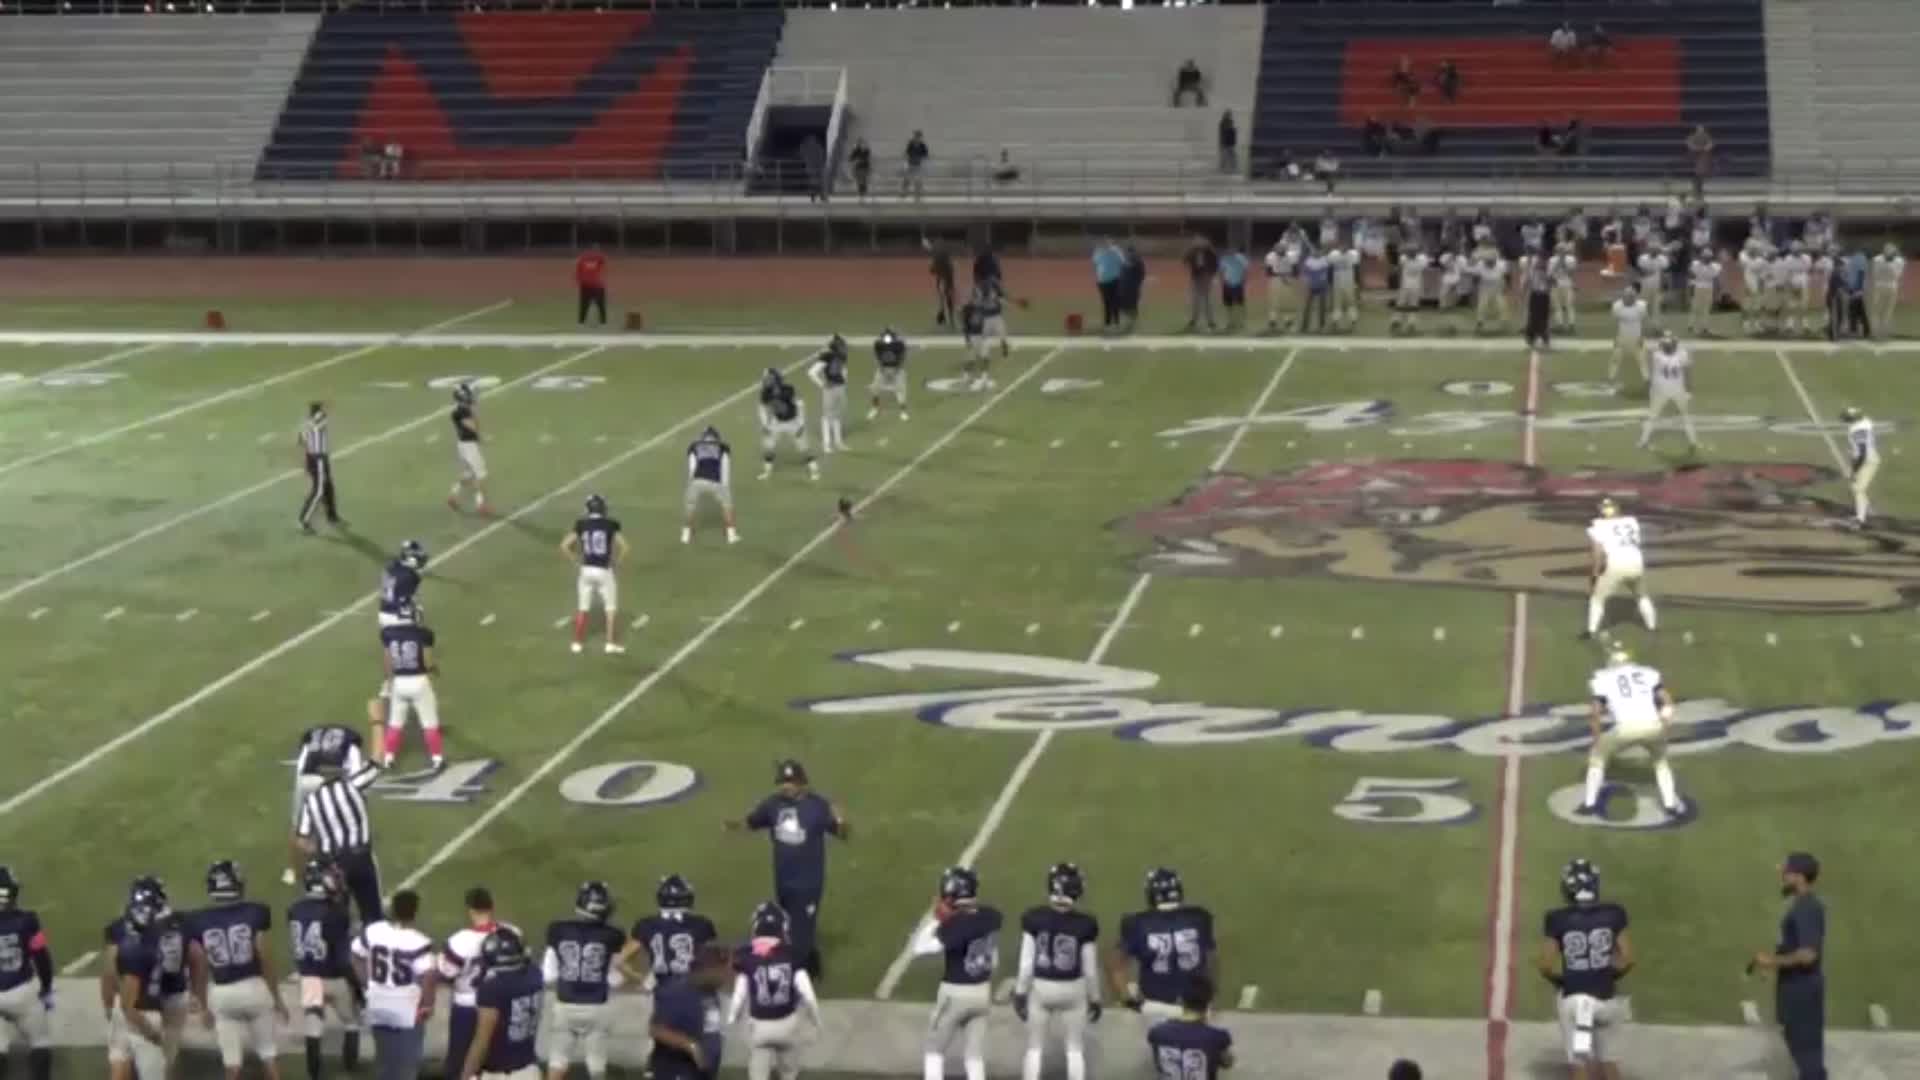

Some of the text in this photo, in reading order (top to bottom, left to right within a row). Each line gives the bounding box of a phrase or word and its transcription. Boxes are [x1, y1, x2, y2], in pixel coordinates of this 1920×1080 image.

[1616, 671, 1649, 700] 85
[371, 945, 413, 986] 65
[1146, 929, 1200, 973] 75
[1563, 928, 1612, 971] 22
[753, 963, 793, 1007] 17
